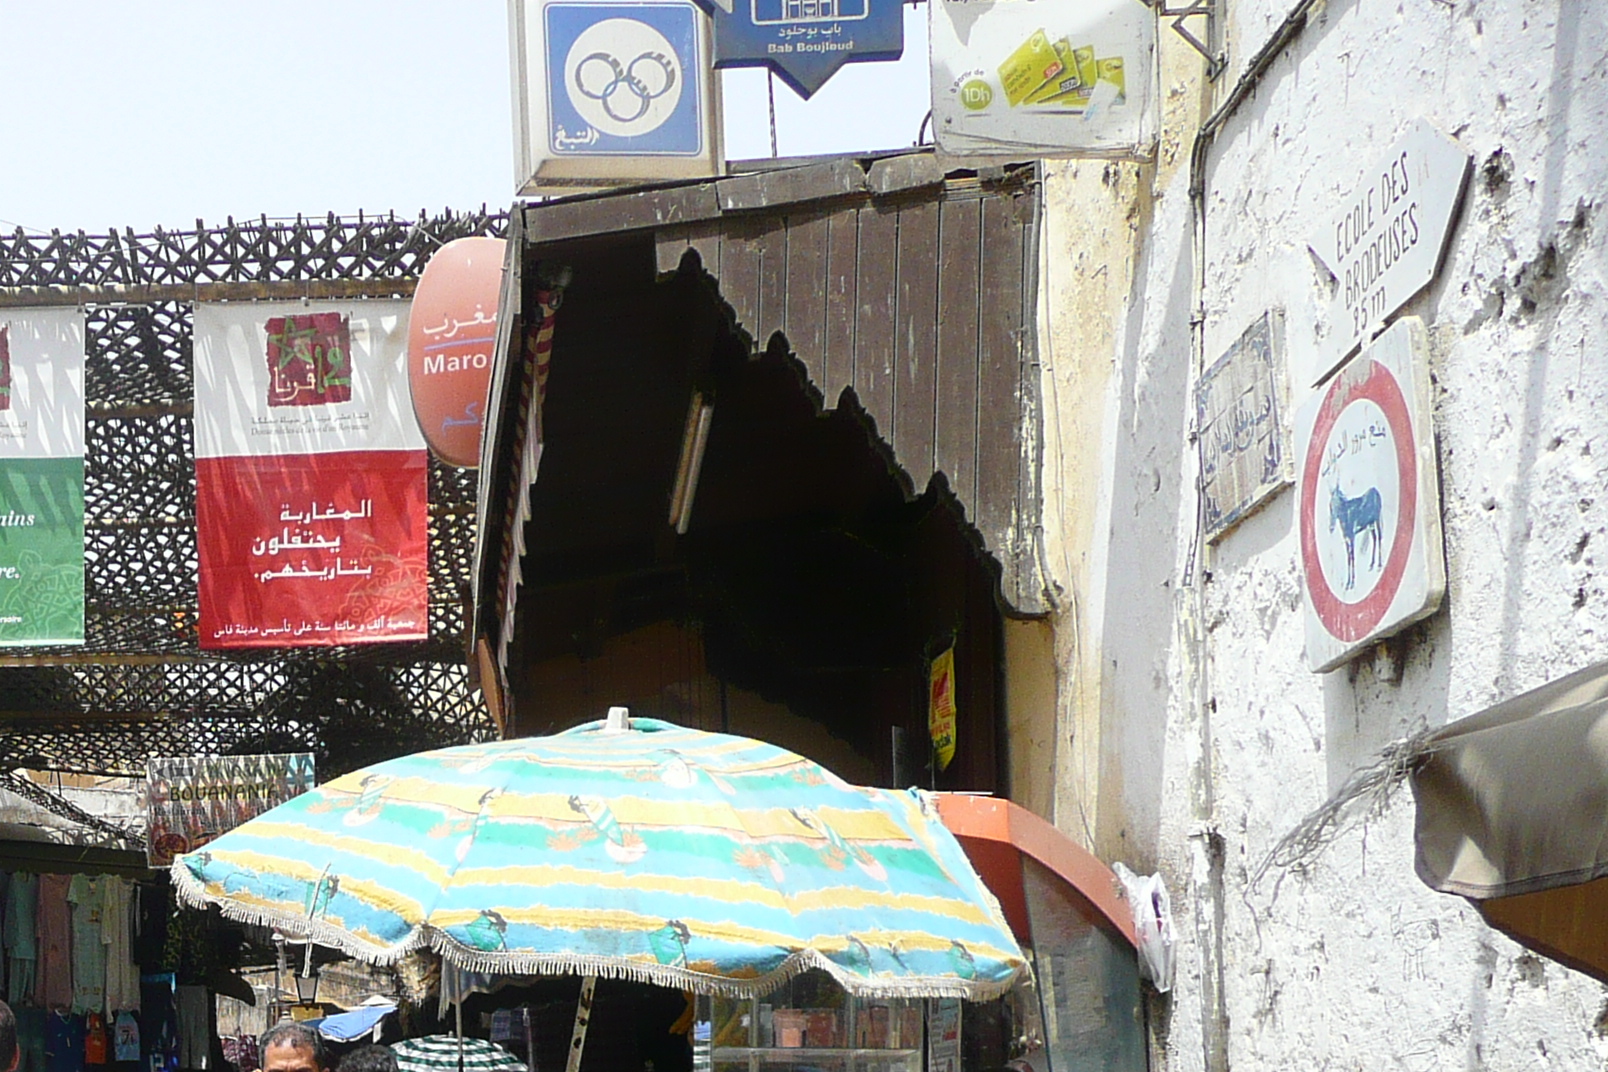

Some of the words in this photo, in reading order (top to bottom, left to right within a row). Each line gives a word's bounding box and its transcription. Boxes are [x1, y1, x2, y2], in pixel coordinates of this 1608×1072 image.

[821, 24, 842, 38] باب
[767, 43, 794, 53] Bab
[974, 69, 985, 77] de
[963, 87, 990, 104] 1Dh
[554, 125, 601, 149] التبغ
[1335, 188, 1376, 263] ECOLE
[1380, 150, 1410, 215] DES
[1344, 201, 1420, 311] BRODEUSES
[1371, 286, 1386, 318] m
[423, 352, 492, 375] Maro
[273, 364, 316, 402] قرنا
[280, 498, 373, 525] المغاربة
[252, 527, 341, 556] يحتفلون
[214, 623, 234, 638] فاس
[235, 624, 260, 635] مدينة
[261, 619, 292, 636] تأسيس
[293, 620, 313, 636] على
[315, 620, 332, 632] سنة
[387, 617, 416, 630] جمعية
